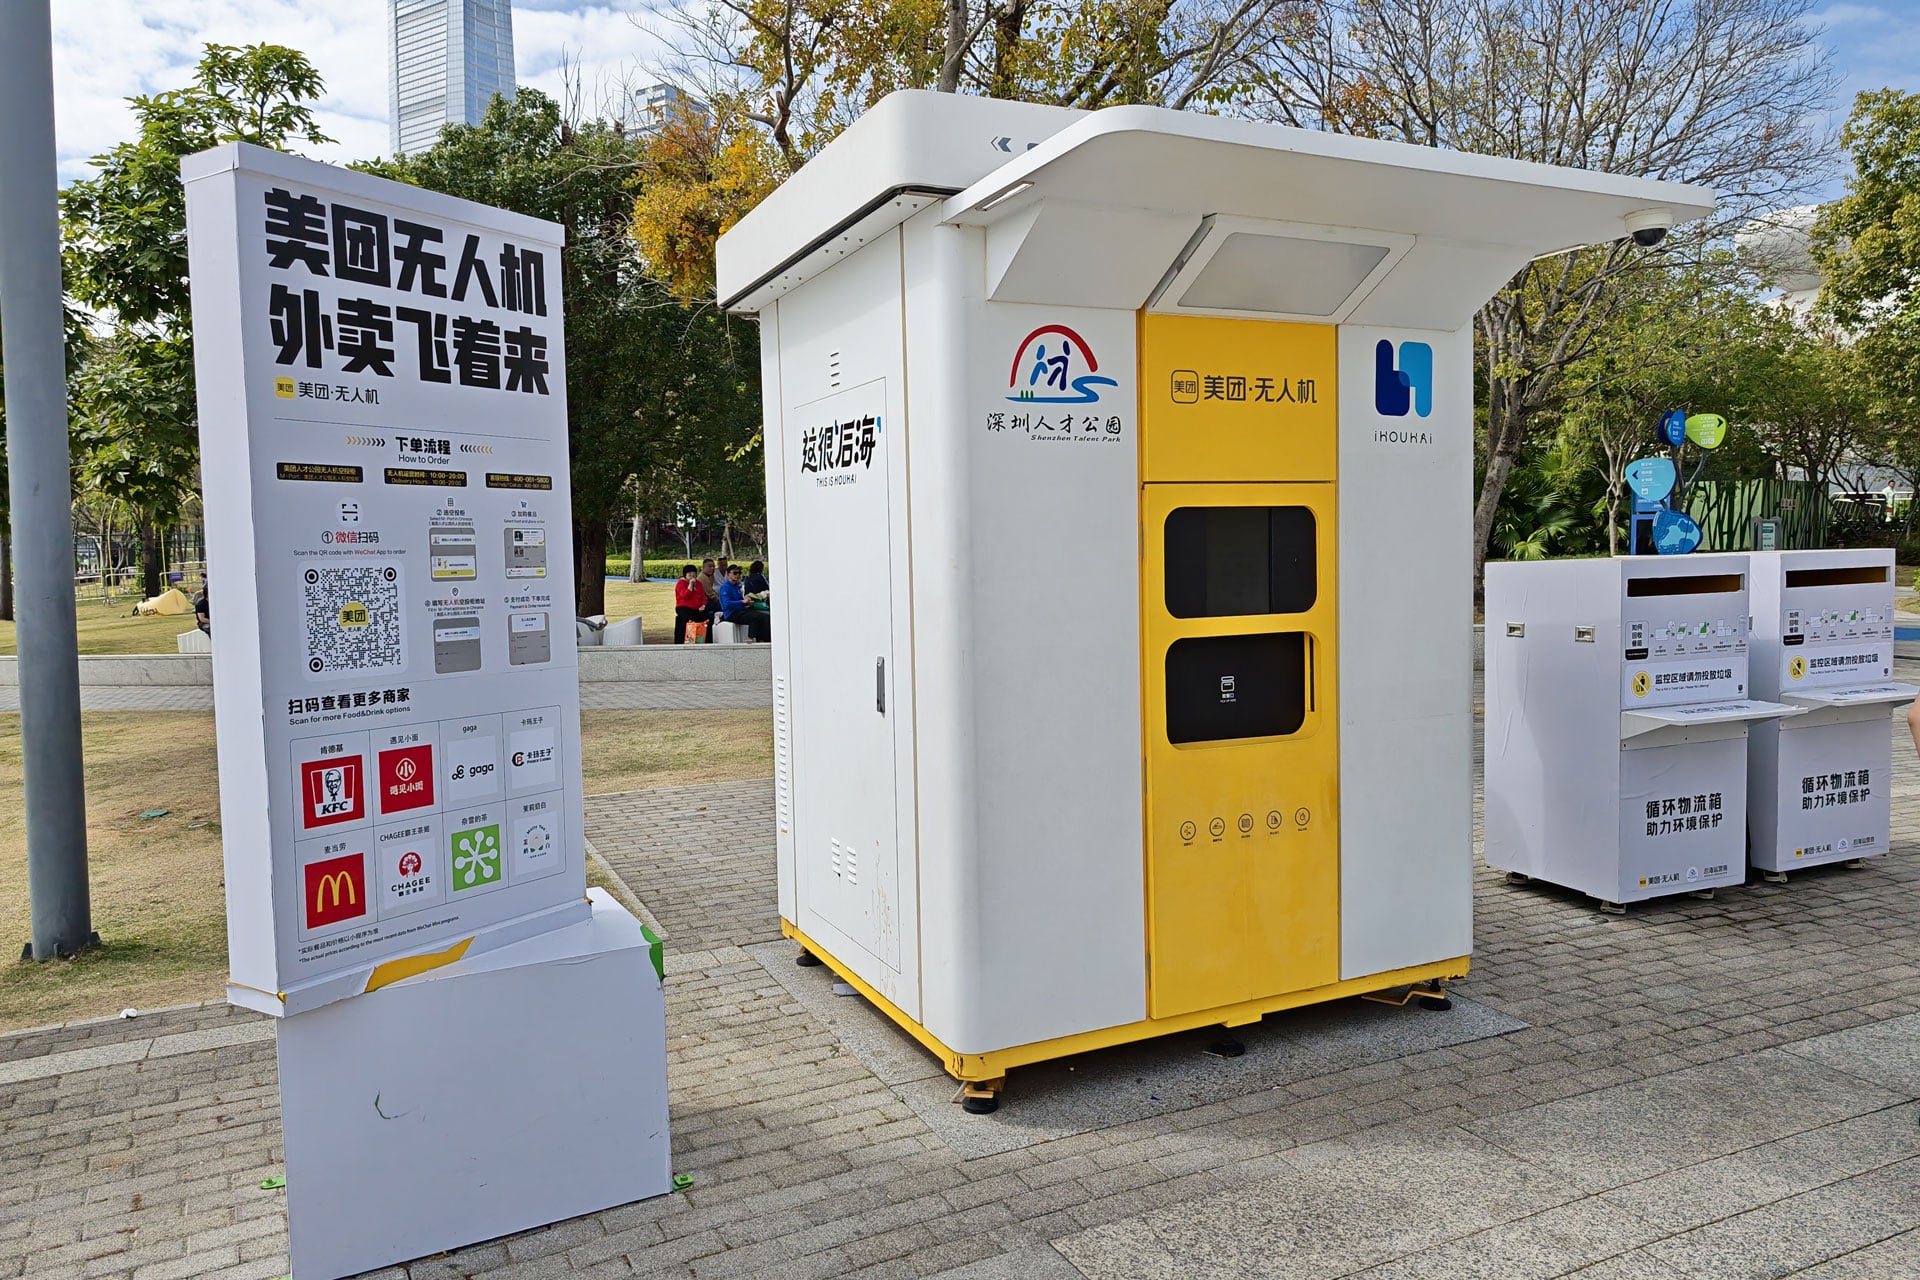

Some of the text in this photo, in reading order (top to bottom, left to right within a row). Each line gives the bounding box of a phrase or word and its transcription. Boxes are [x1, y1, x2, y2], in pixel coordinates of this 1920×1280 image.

[264, 187, 547, 317] 美团无人机
[269, 283, 549, 395] 外卖飞着来
[276, 381, 380, 405] 美团 美团·无人机
[1174, 374, 1317, 404] 美团 美团·无人机
[987, 412, 1121, 434] 深圳人才公园
[395, 436, 451, 455] 下单流程
[398, 454, 450, 465] How to Order
[335, 531, 380, 544] 微信扫码
[342, 609, 367, 623] 美团
[1810, 653, 1879, 669] 监控区域请勿投放垃圾
[1655, 668, 1732, 685] 监控区域请勿投放垃圾
[288, 687, 410, 715] 扫码查看更多商家
[289, 705, 411, 726] Scan for more Food&Drink options
[462, 725, 477, 734] gaga
[390, 733, 419, 745] 遇见小面
[320, 743, 344, 755] 肯德基
[469, 763, 494, 778] gaga
[1802, 769, 1870, 794] 循环物流箱
[321, 800, 348, 815] KFC
[1646, 792, 1722, 819] 循环物流箱
[1802, 787, 1870, 810] 助力环境保护
[1646, 812, 1722, 836] 助力环境保护
[323, 842, 347, 854] 麦当劳
[391, 876, 431, 892] CHAGEE
